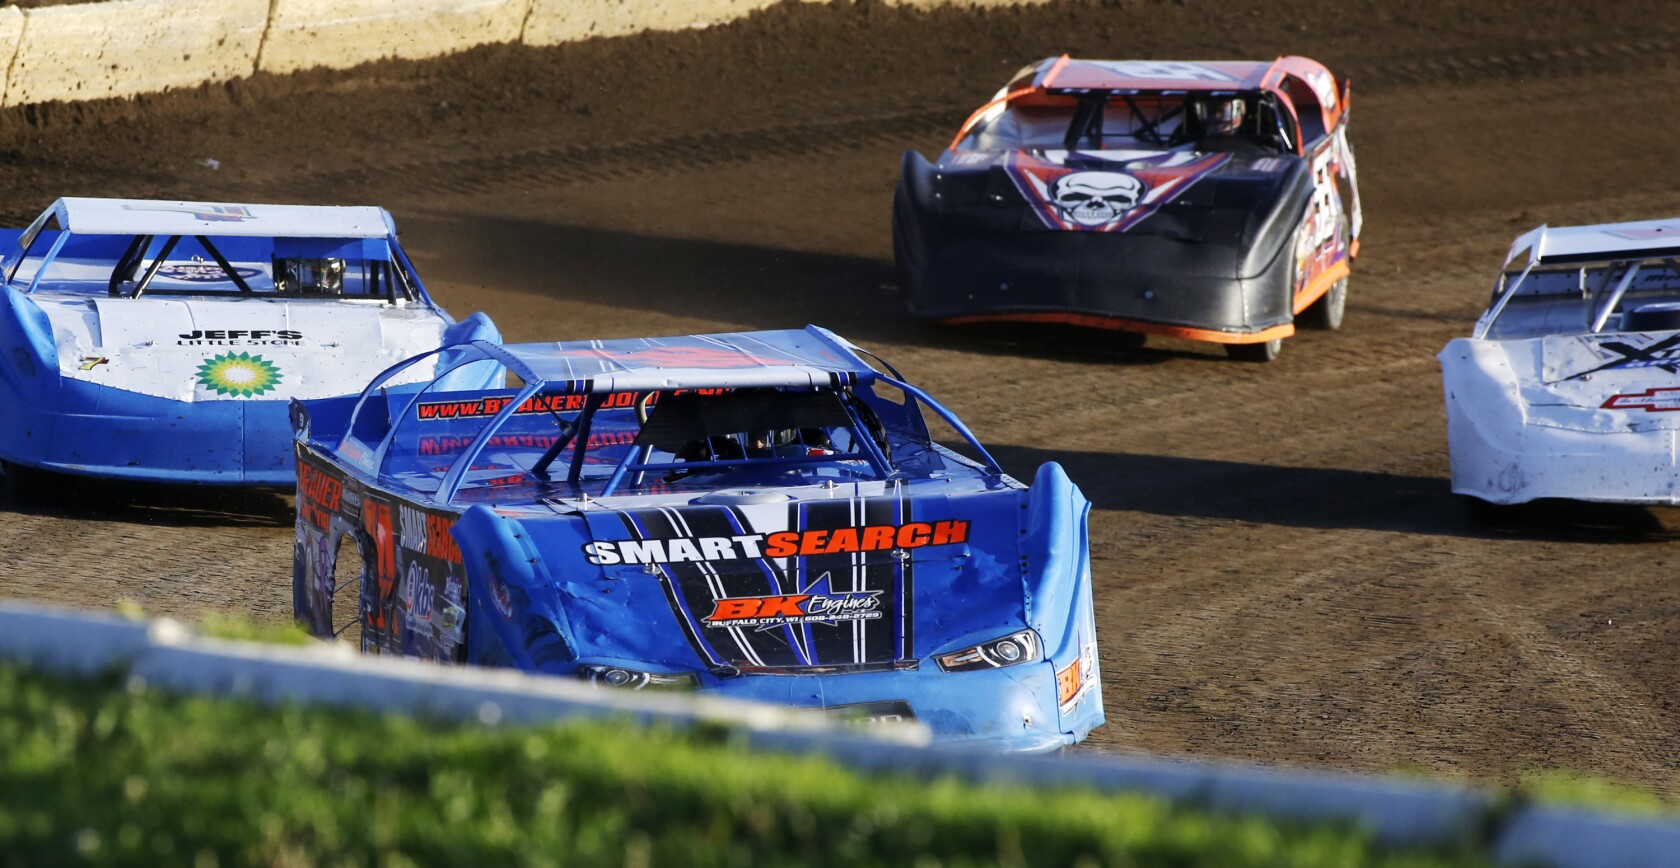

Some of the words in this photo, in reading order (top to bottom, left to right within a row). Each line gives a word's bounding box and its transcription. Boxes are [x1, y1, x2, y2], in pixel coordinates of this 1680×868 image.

[179, 330, 303, 340] JEFF'S
[708, 596, 809, 620] BK
[807, 594, 875, 615] Engines
